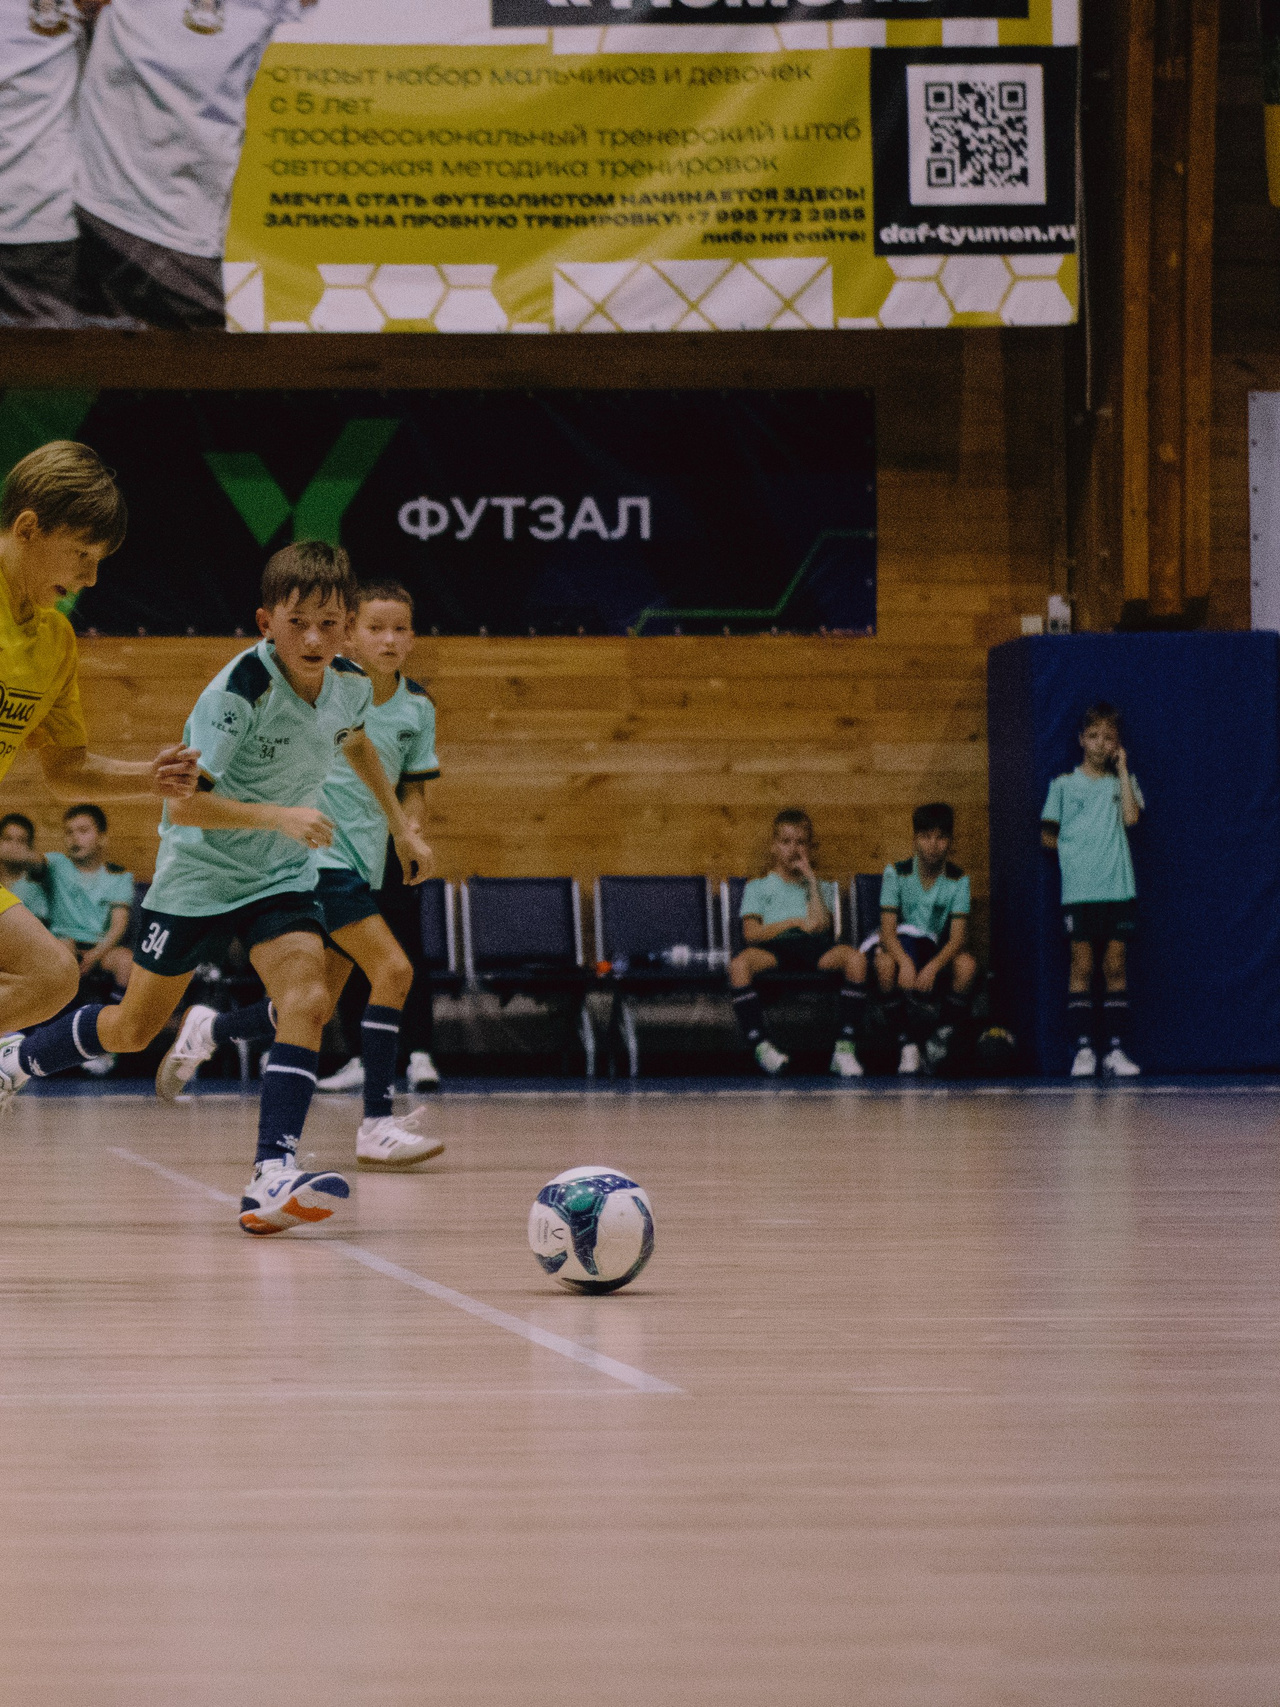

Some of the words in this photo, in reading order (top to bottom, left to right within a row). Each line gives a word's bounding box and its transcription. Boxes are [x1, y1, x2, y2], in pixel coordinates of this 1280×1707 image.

[385, 63, 481, 86] набор
[491, 65, 656, 85] мальчиков
[664, 65, 682, 83] и
[689, 62, 811, 87] девочек
[270, 96, 287, 114] с
[296, 92, 314, 114] 5
[322, 96, 372, 115] лет
[596, 120, 775, 148] тренерский
[782, 117, 862, 142] штаб
[442, 157, 588, 178] методика
[596, 156, 779, 178] тренировок
[270, 192, 351, 208] МЕЧТА
[356, 192, 429, 208] СТАТЬ
[433, 191, 615, 208] ФУТБОЛИСТОМ
[263, 213, 360, 229] ЗАПИСЬ
[365, 213, 398, 229] НА
[402, 212, 519, 229] ПРОБНУЮ
[701, 228, 757, 244] либо
[761, 231, 789, 244] на
[879, 223, 1076, 247] daf-tyumen.ru
[397, 495, 652, 541] ФУТЗАЛ
[259, 744, 276, 760] 34
[141, 922, 170, 961] 34
